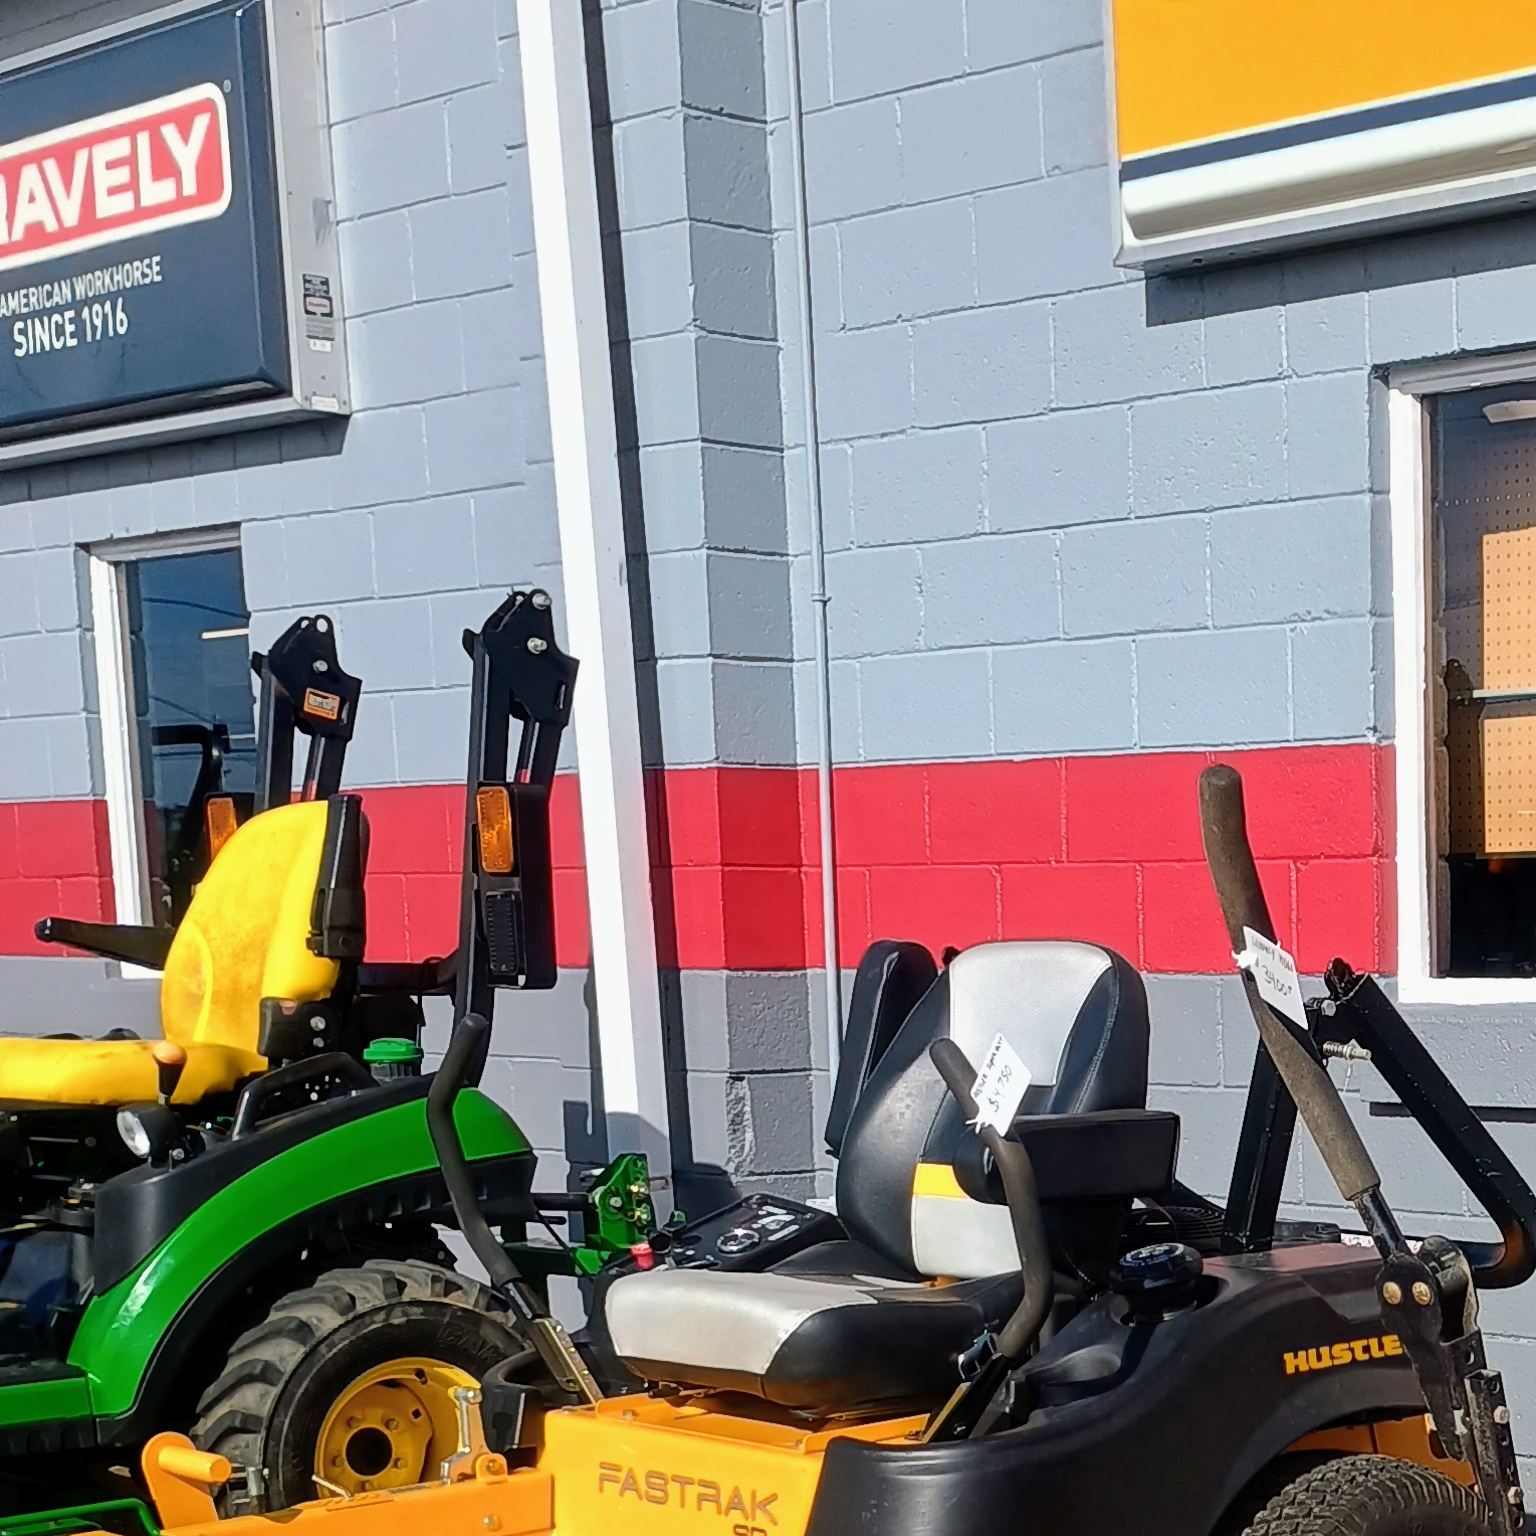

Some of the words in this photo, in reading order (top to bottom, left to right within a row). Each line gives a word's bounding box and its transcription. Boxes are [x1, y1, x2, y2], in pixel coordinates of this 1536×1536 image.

[0, 112, 211, 246] AVELY
[0, 278, 72, 319] AMERICAN
[72, 255, 163, 301] WORKHORSE
[13, 309, 78, 357] SINCE
[81, 297, 128, 343] 1916
[1283, 1334, 1404, 1375] HUSTLE
[598, 1461, 779, 1526] FASTRAK
